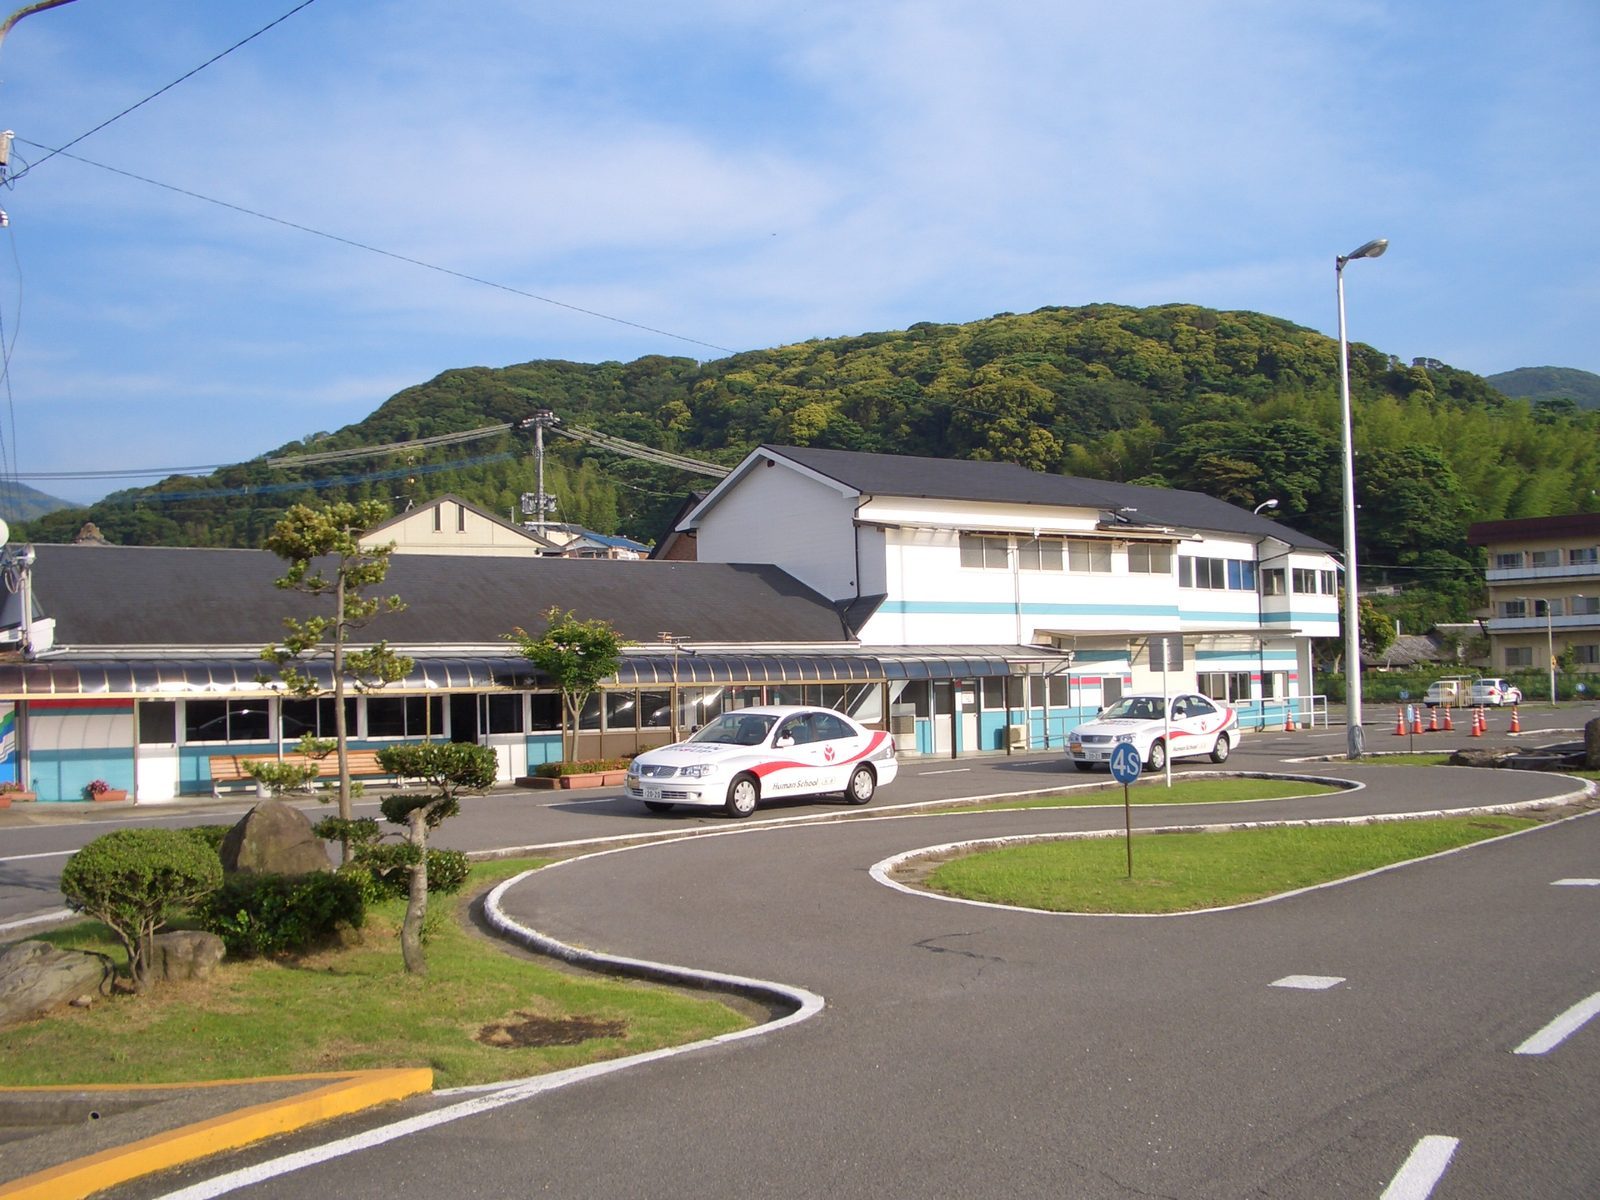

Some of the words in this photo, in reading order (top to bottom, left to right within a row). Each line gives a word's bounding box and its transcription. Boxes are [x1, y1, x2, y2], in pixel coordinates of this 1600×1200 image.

[1112, 748, 1140, 776] 4S
[772, 781, 796, 790] Human
[796, 778, 819, 788] School
